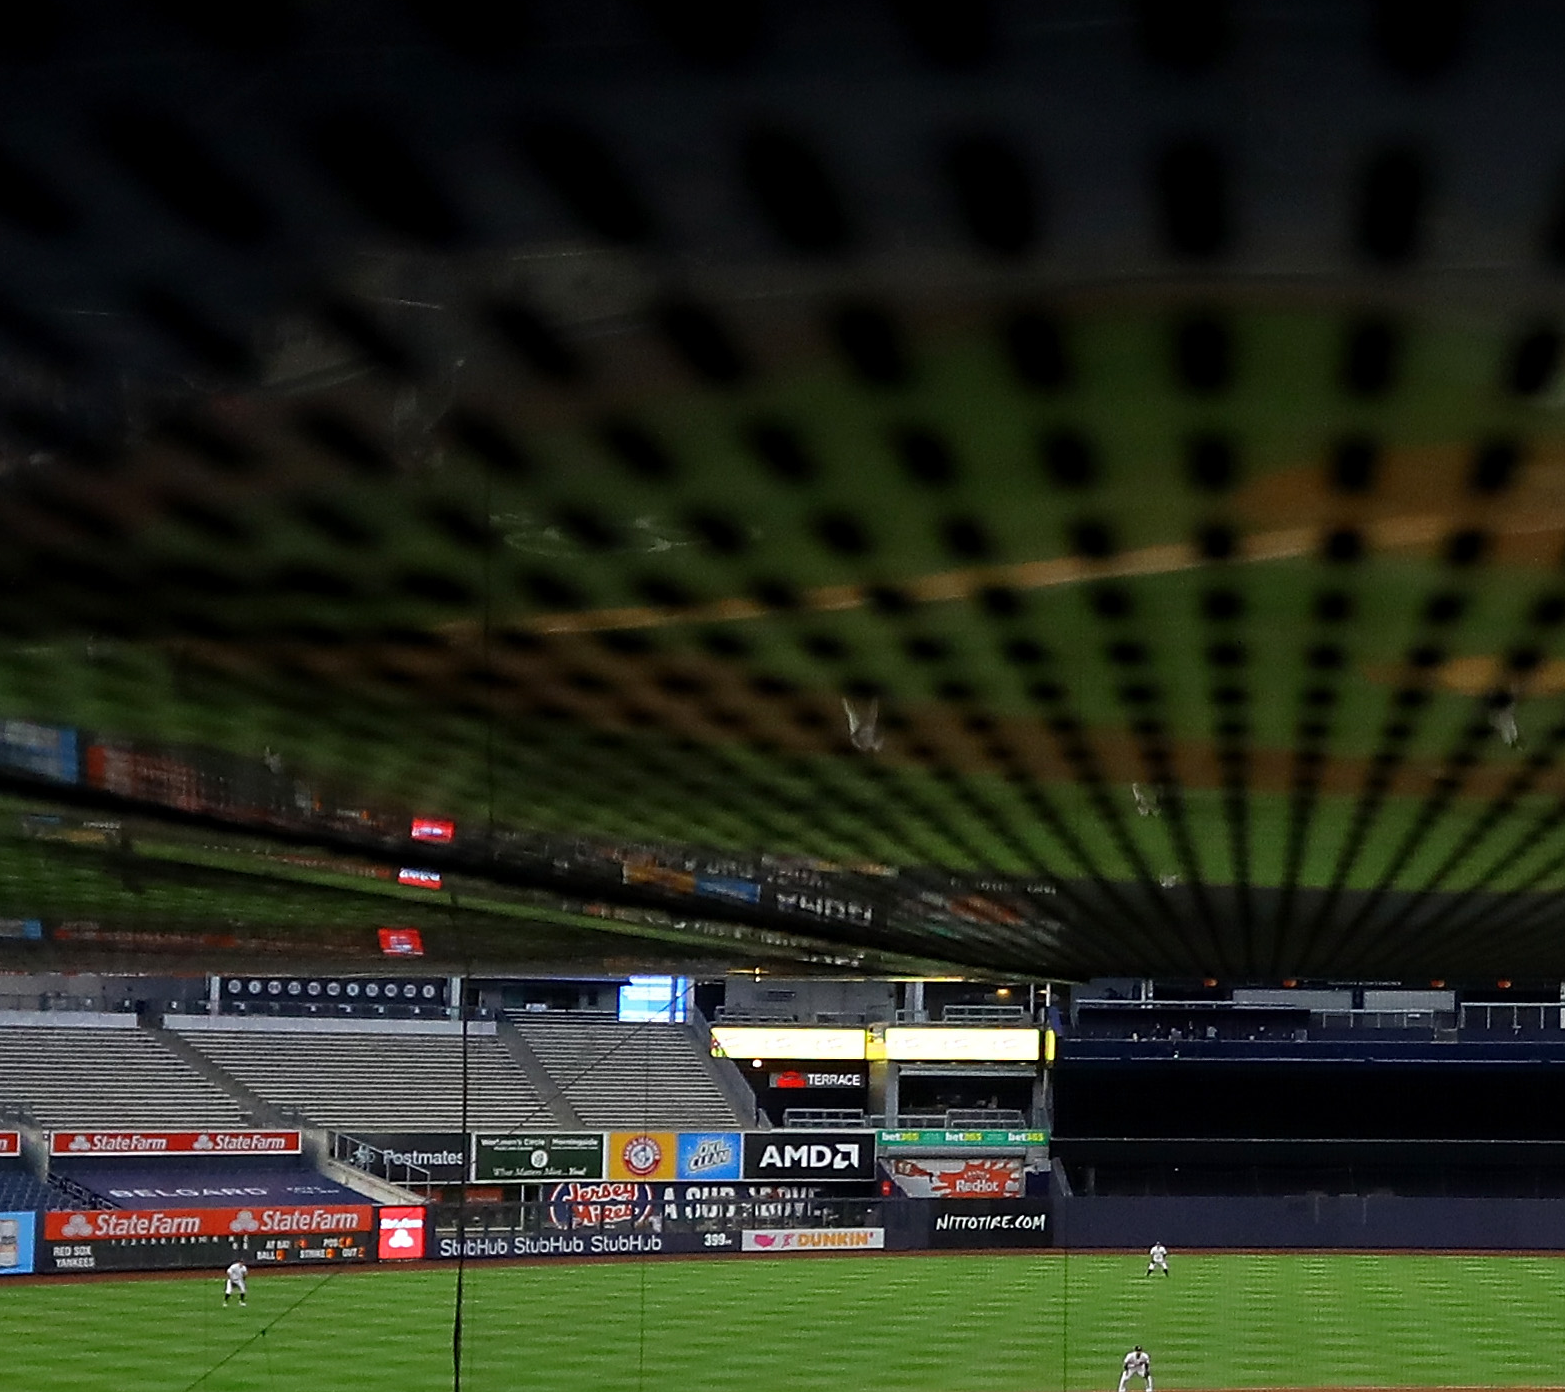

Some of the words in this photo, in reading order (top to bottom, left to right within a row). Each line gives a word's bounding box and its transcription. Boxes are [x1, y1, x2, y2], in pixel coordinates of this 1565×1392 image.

[807, 1073, 861, 1087] TERRACE
[689, 1149, 732, 1172] CLEAN
[759, 1145, 833, 1168] AMD
[935, 1212, 1046, 1232] NITTOTIRE.COM
[439, 1238, 508, 1257] StubHub
[513, 1236, 584, 1254] StubHub
[590, 1234, 663, 1253] StubHub
[704, 1233, 726, 1247] 399
[797, 1231, 874, 1248] DUNKIN'
[53, 1246, 73, 1257] RED
